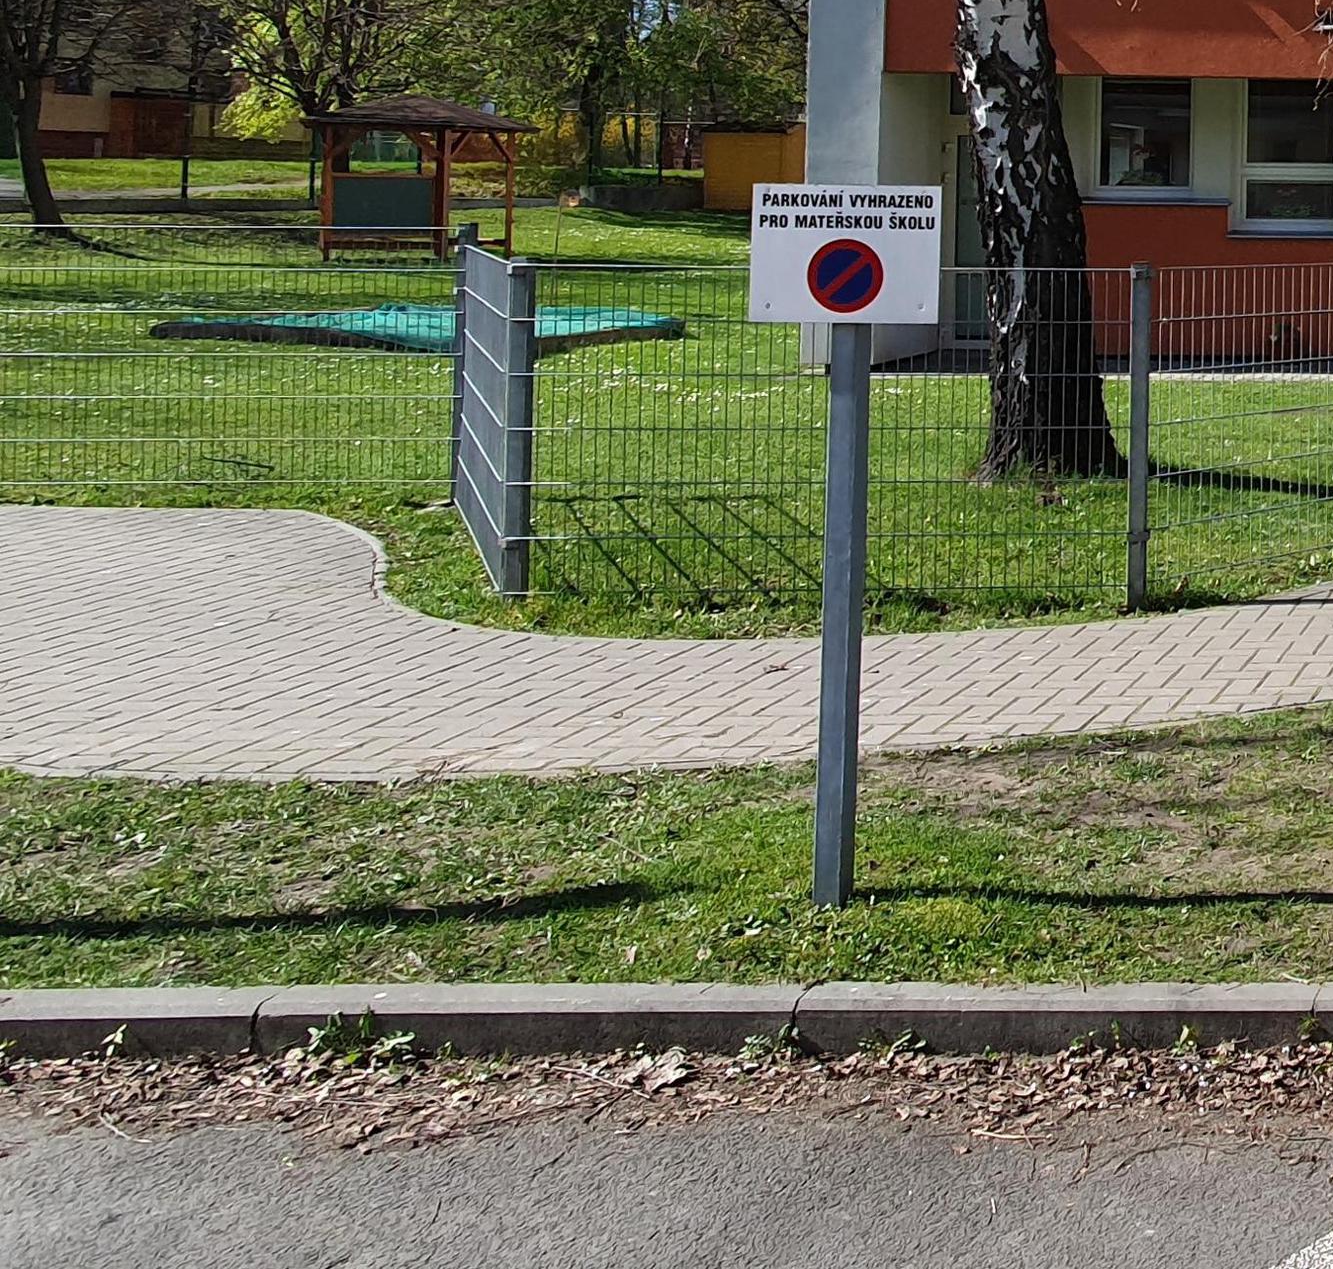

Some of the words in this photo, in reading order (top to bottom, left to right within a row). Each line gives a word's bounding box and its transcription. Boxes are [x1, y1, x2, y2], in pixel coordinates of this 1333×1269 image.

[762, 190, 843, 208] PARKOVÁNÍ
[849, 194, 934, 209] VYHRAZENO
[759, 214, 788, 228] PRO
[795, 211, 883, 229] MATEŘSKOU
[888, 212, 936, 230] ŠKOLU
